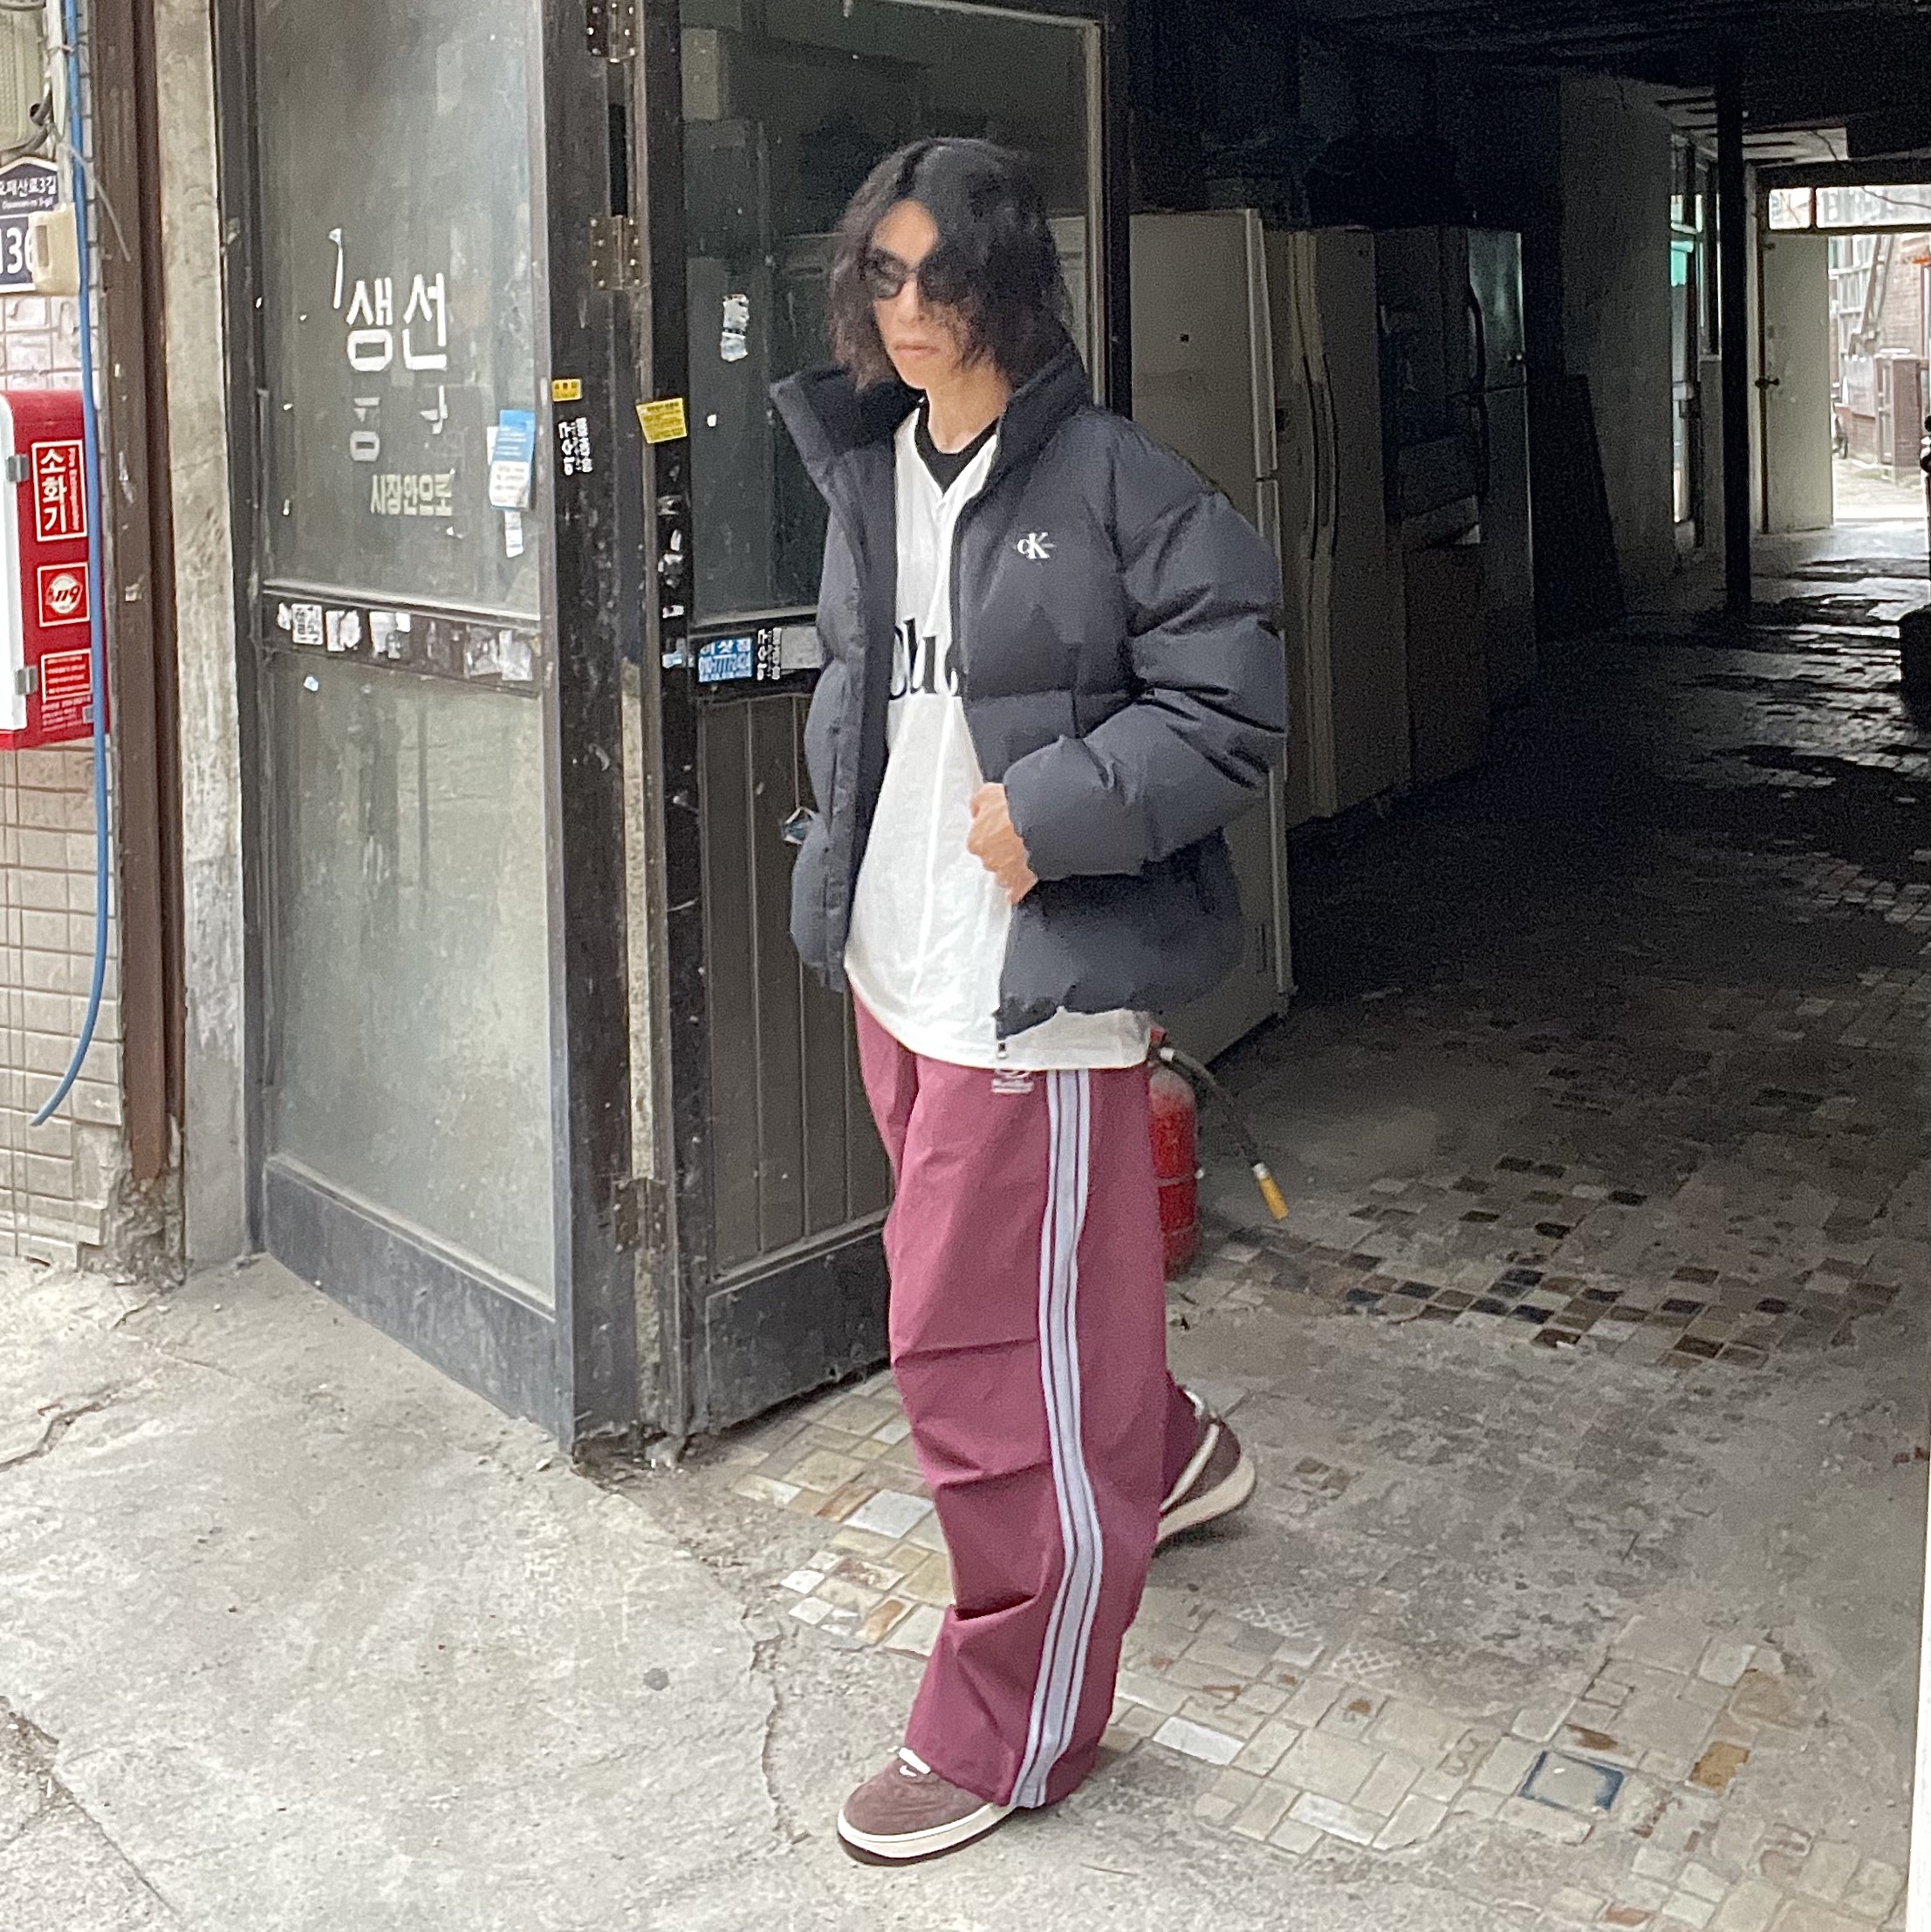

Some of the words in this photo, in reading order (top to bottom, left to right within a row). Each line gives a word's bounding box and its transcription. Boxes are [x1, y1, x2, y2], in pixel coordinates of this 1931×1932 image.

[346, 273, 447, 371] 생선
[40, 449, 67, 532] 소화기
[370, 474, 452, 517] 시장안으로
